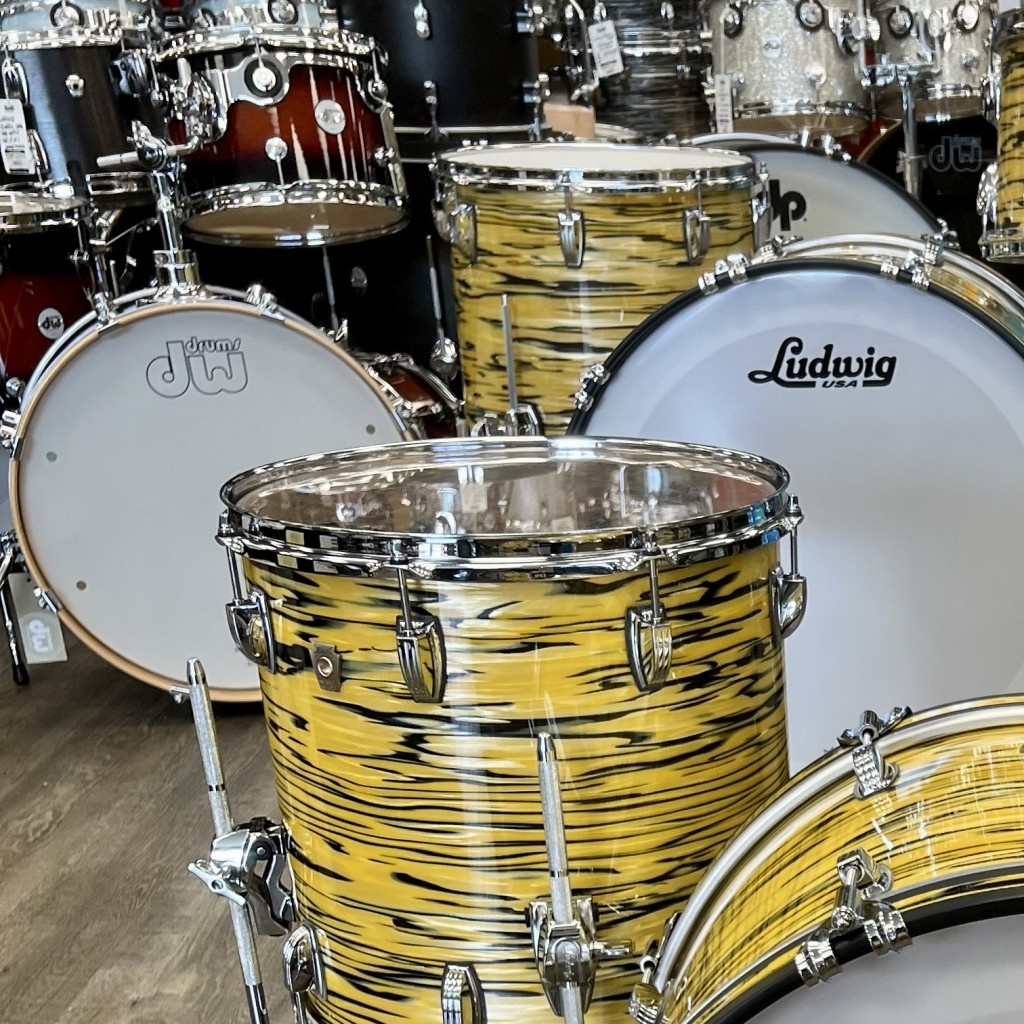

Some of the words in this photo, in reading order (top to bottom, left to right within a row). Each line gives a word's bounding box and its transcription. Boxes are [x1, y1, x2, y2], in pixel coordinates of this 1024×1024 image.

[146, 340, 248, 399] dw
[747, 336, 897, 388] Ludwig
[821, 380, 858, 388] USA
